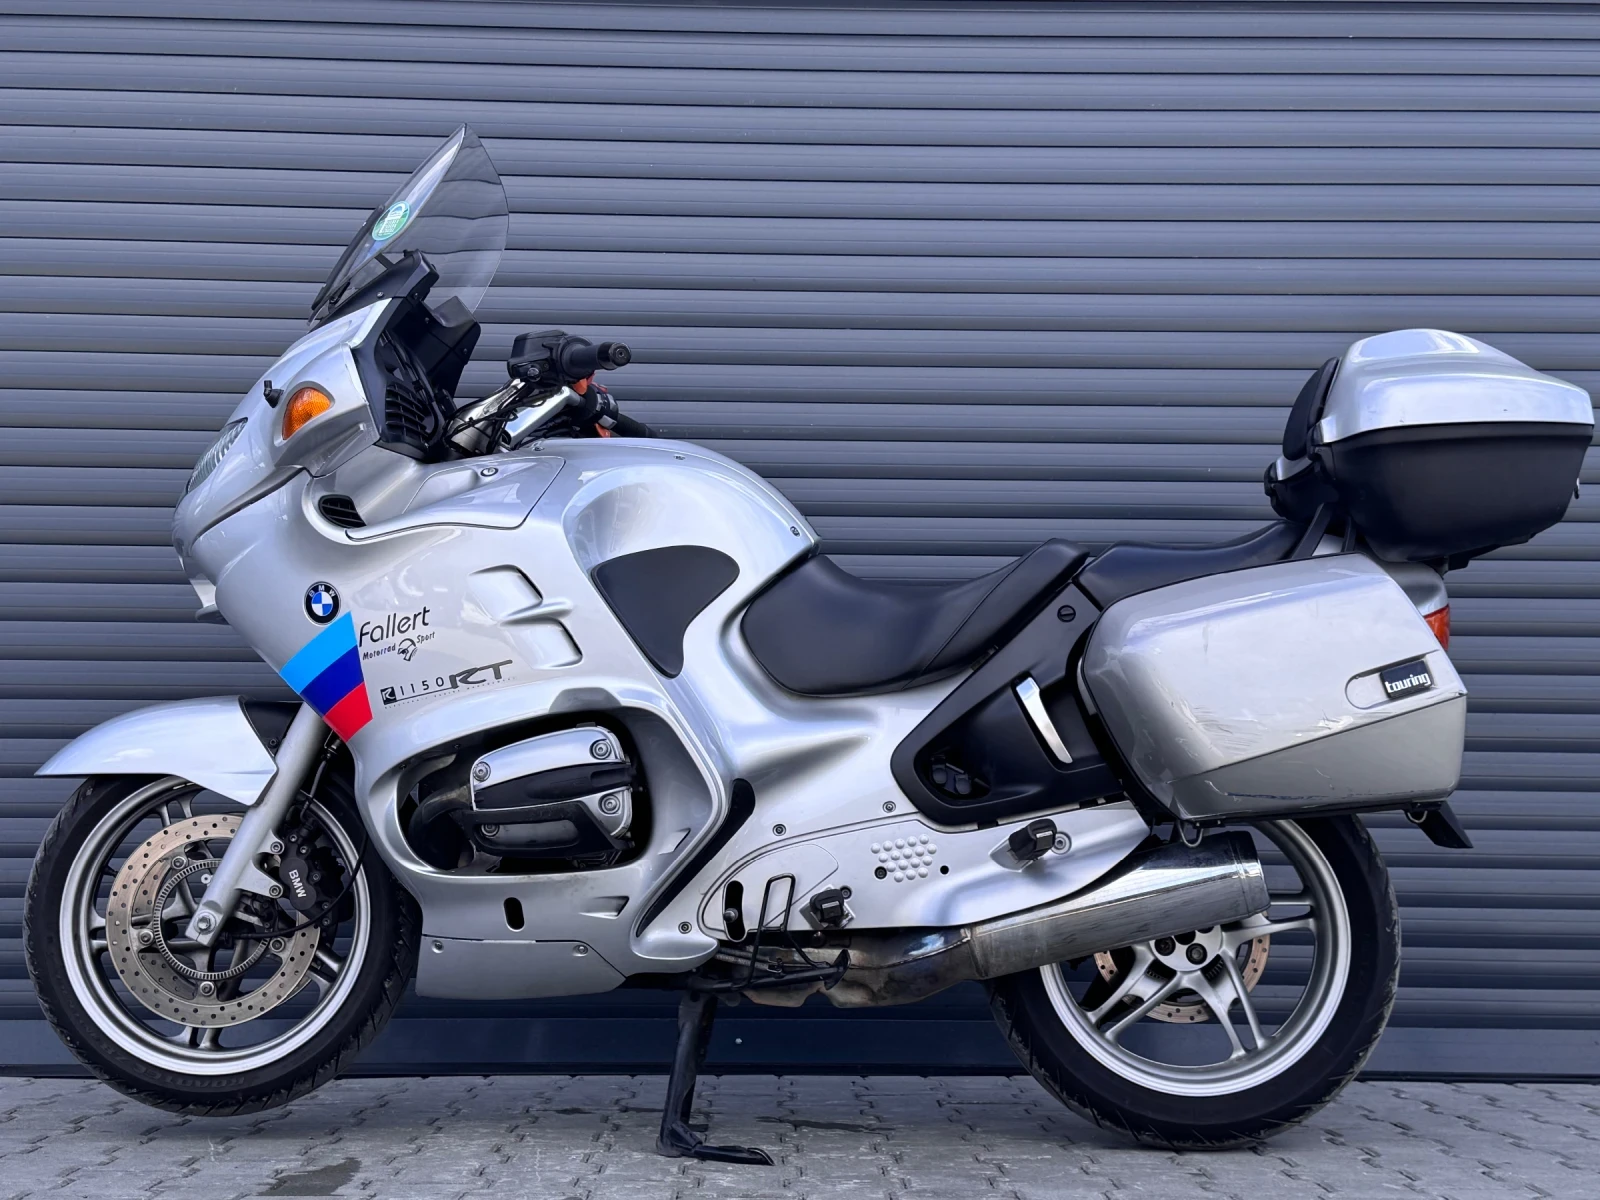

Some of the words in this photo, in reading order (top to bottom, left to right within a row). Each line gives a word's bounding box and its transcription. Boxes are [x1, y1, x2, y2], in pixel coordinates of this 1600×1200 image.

[309, 584, 336, 597] BMW
[359, 606, 430, 647] Fallert
[362, 643, 396, 661] Motorrad
[416, 631, 437, 644] Sport
[1384, 673, 1431, 693] touring
[289, 869, 307, 898] BMW
